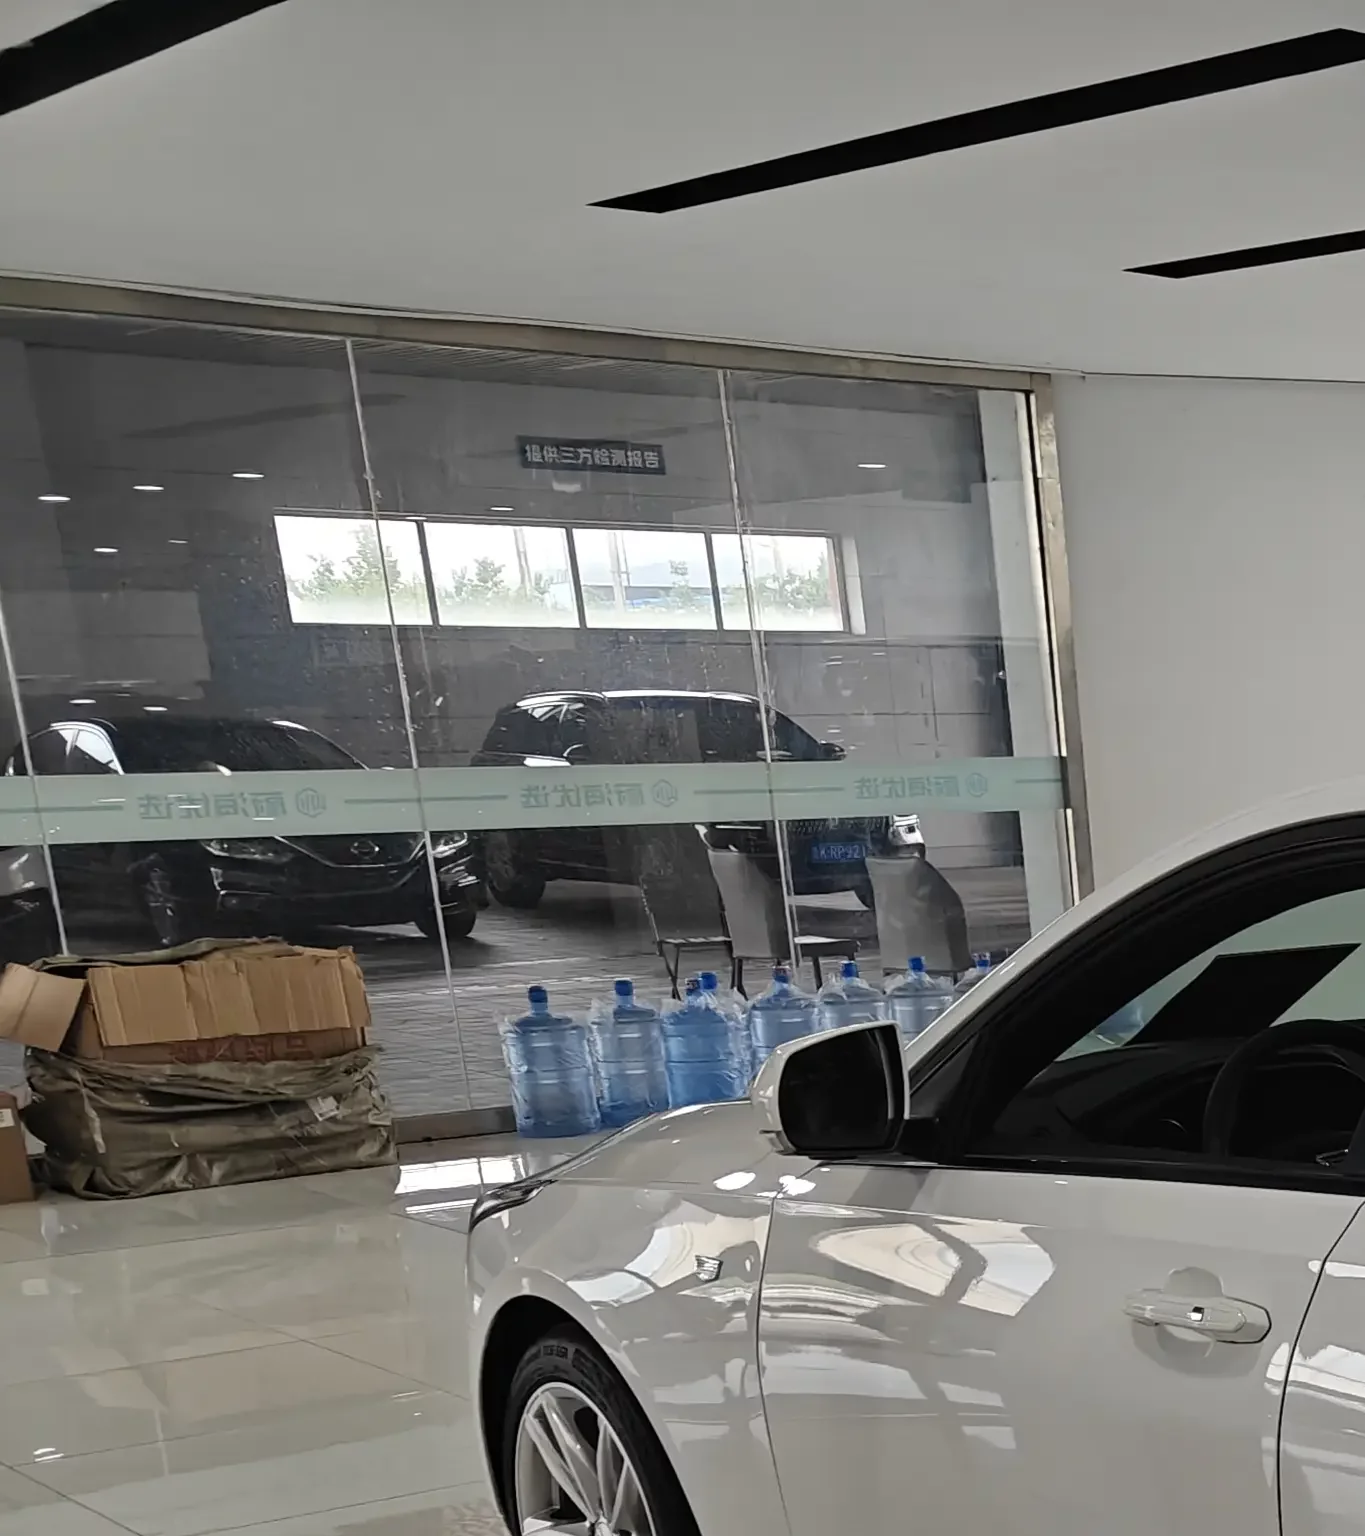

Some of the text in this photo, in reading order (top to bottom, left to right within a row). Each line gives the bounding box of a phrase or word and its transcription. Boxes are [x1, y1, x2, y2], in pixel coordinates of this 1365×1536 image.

[525, 443, 660, 469] 提供三方检测报告
